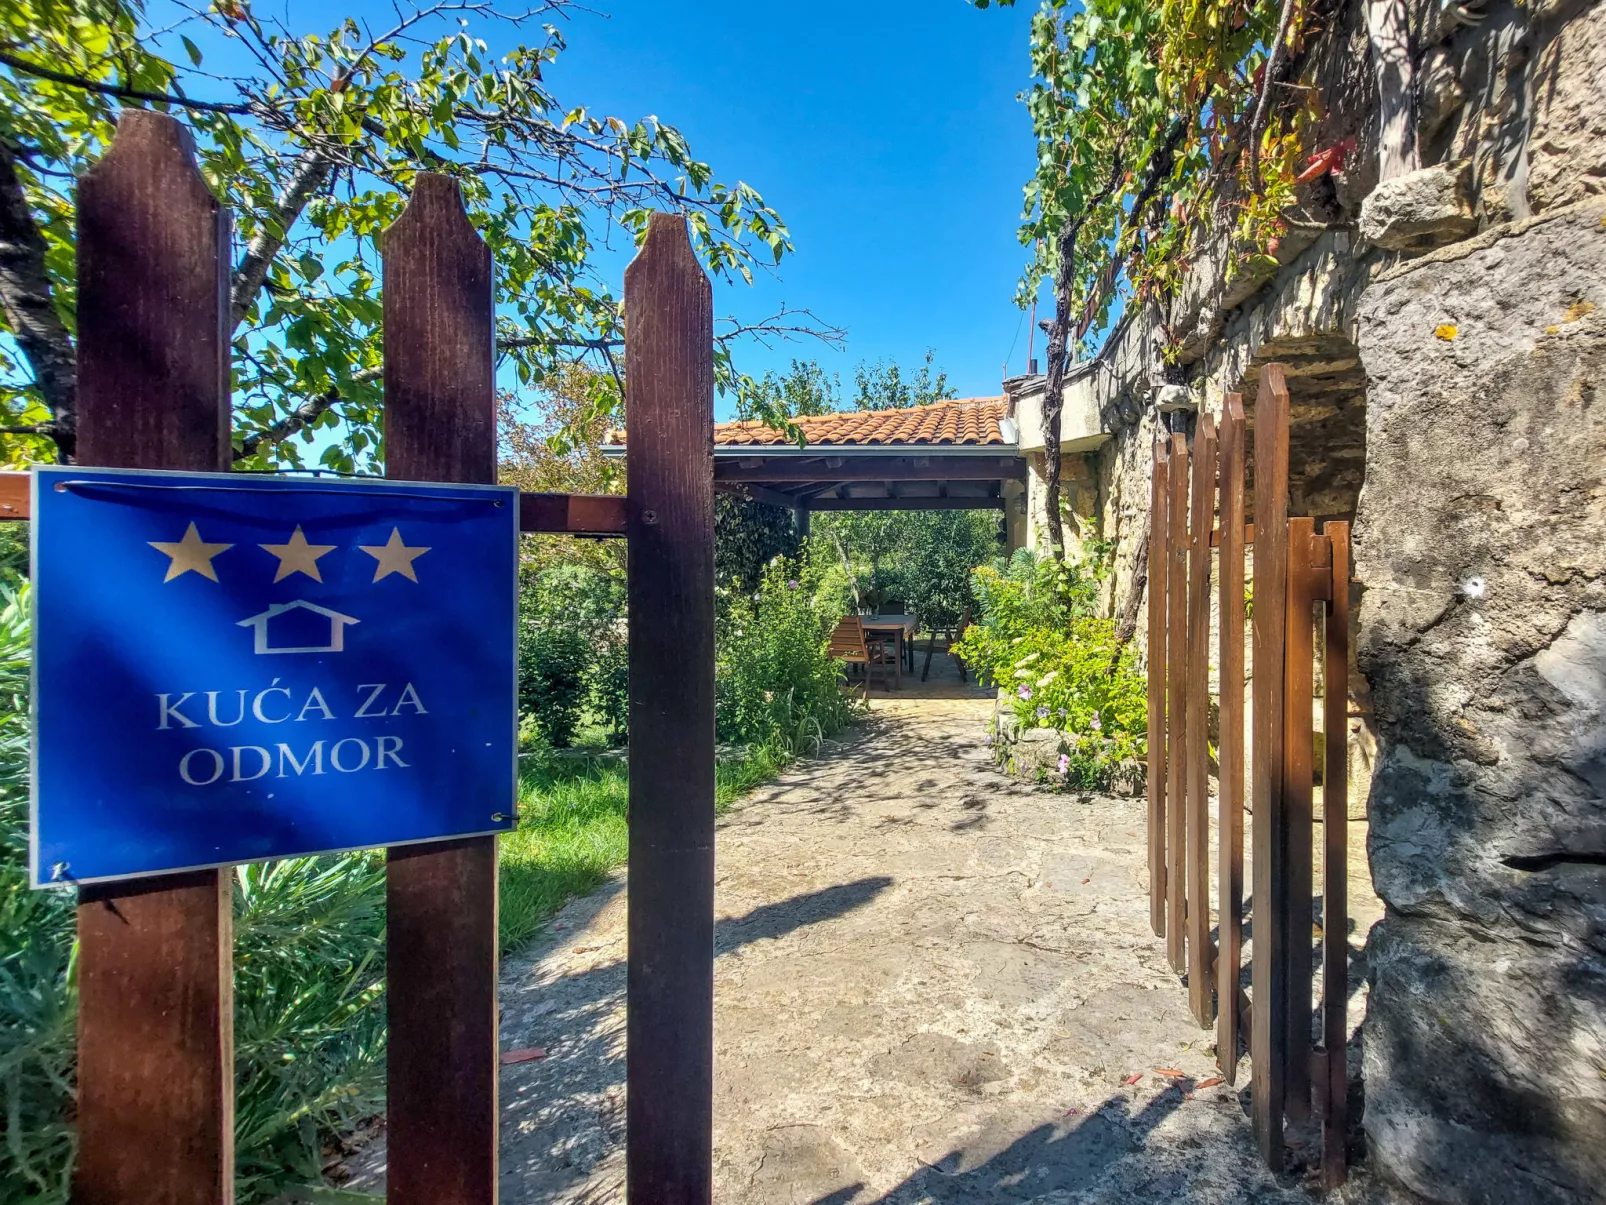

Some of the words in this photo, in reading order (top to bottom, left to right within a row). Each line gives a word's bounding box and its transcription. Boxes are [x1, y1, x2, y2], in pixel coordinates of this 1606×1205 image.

[156, 678, 337, 729] KUĆA
[354, 682, 429, 718] ZA
[180, 736, 411, 786] ODMOR
